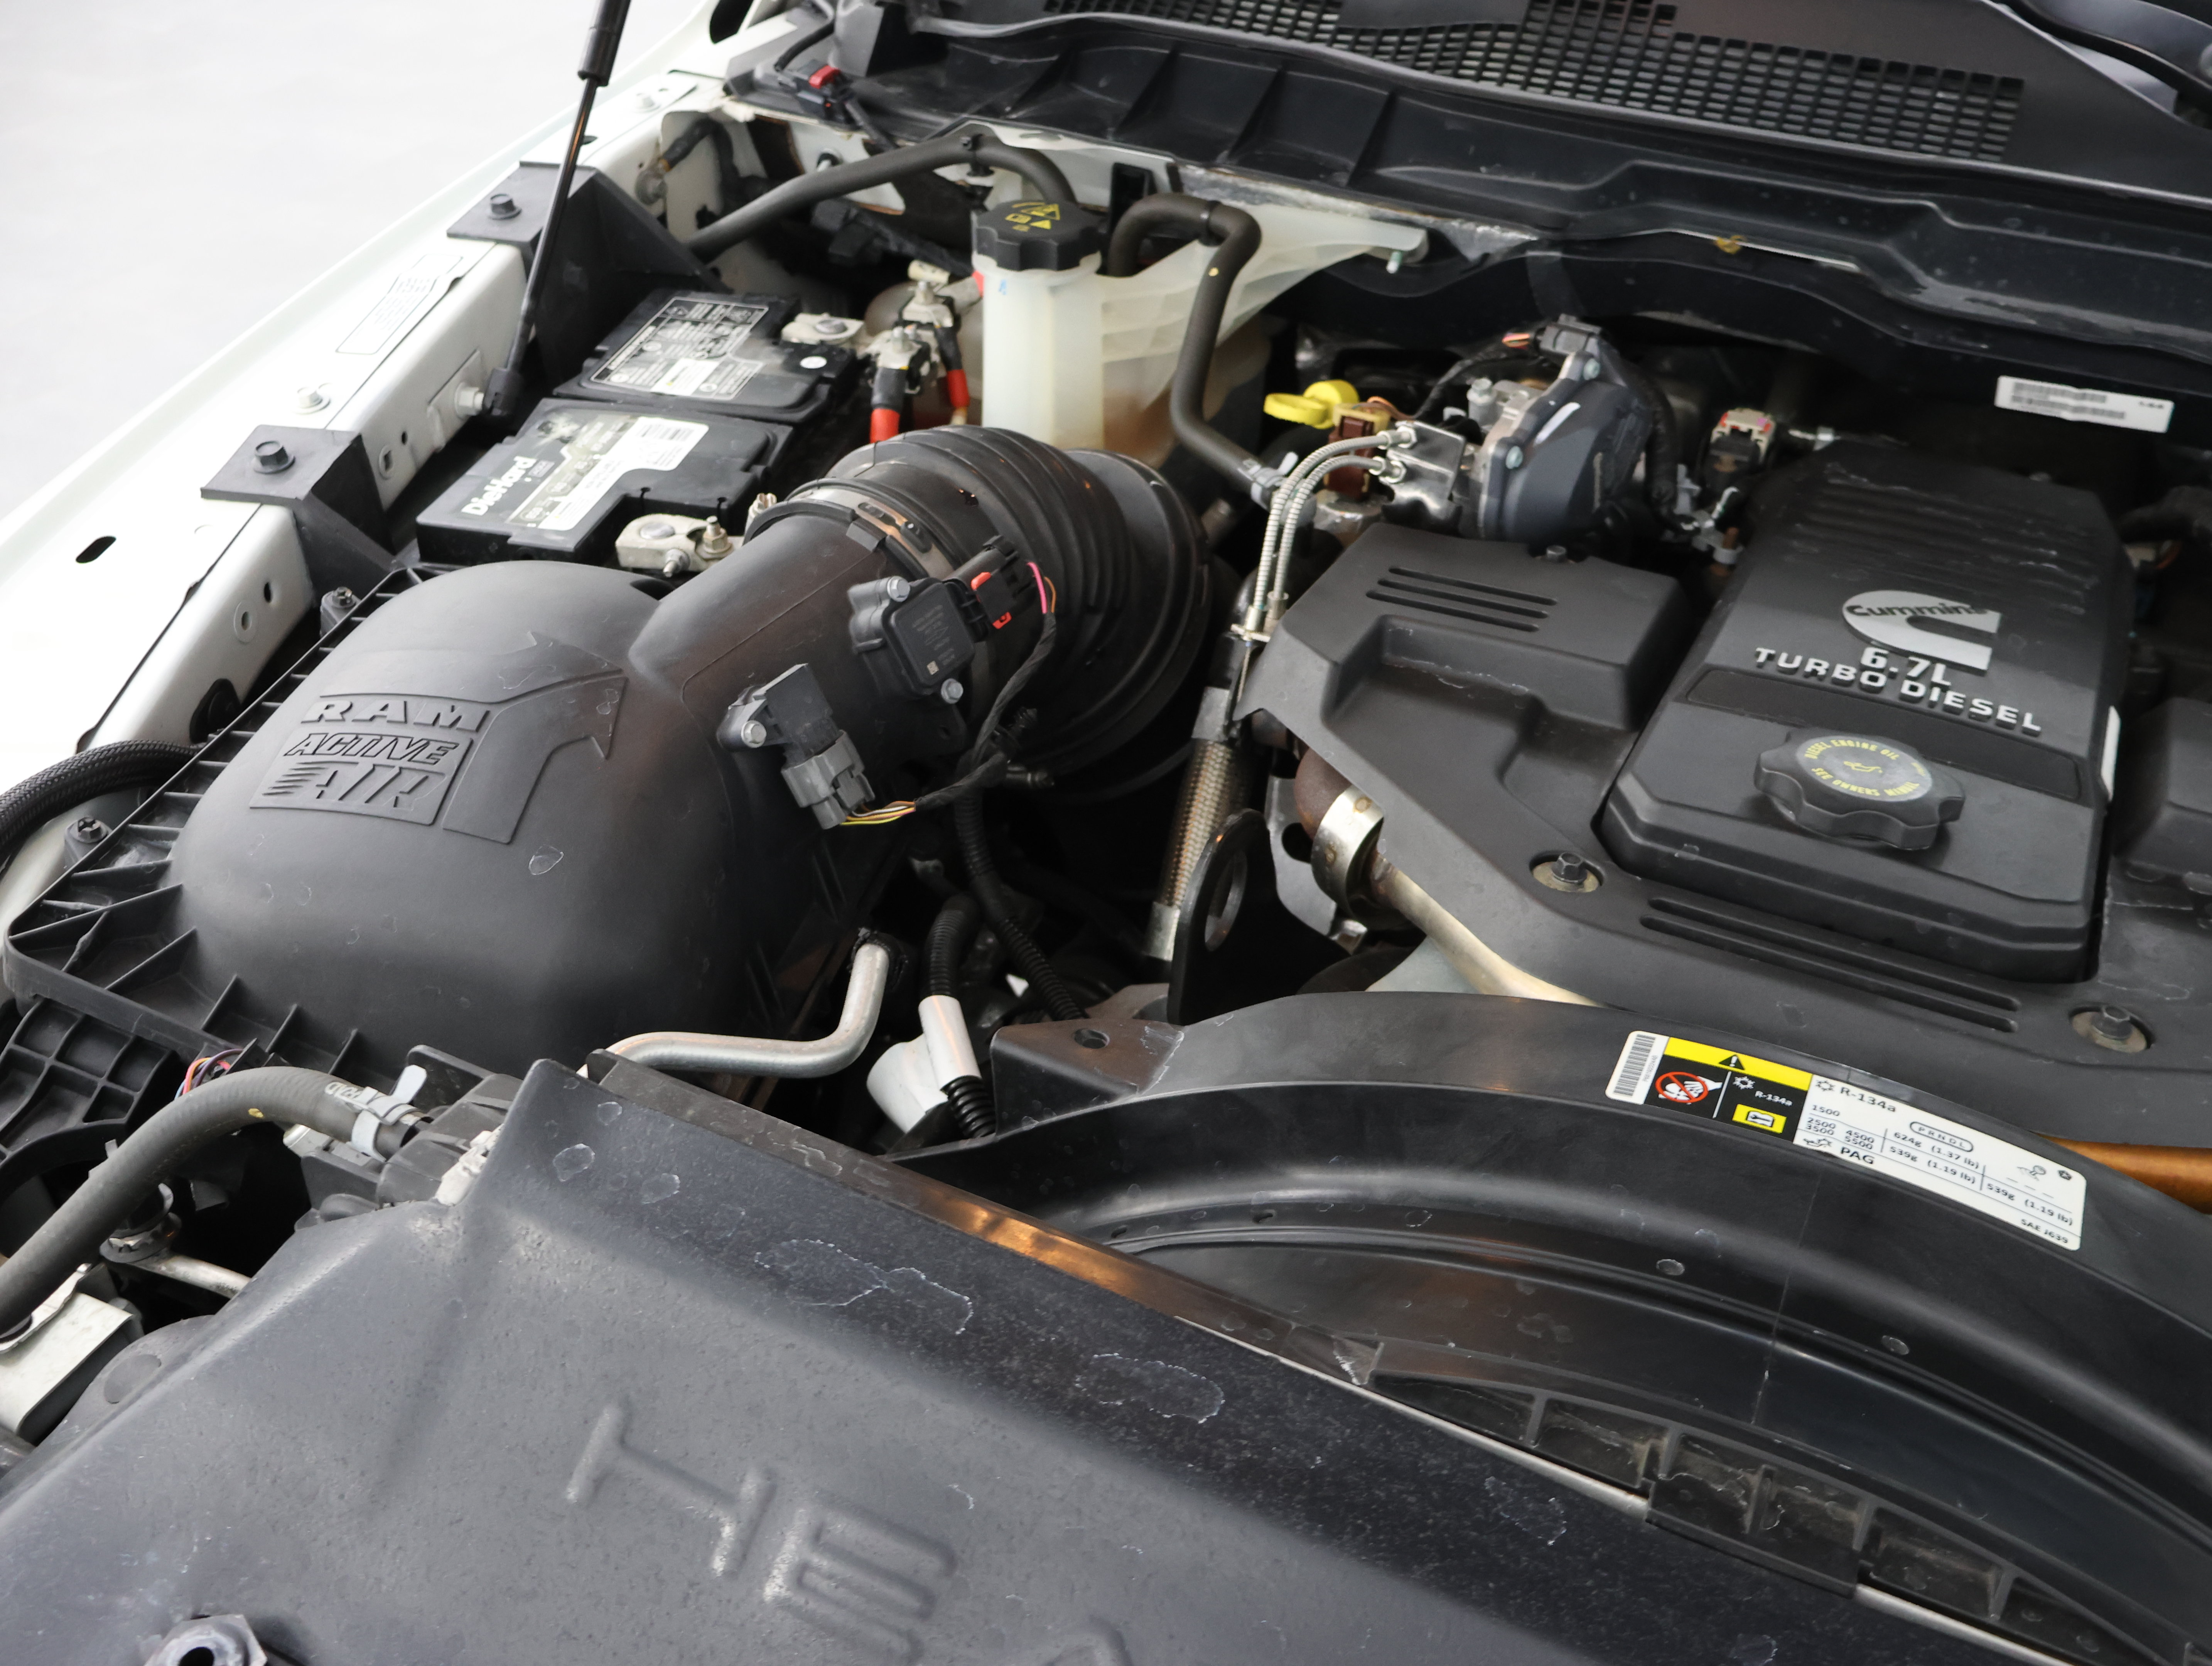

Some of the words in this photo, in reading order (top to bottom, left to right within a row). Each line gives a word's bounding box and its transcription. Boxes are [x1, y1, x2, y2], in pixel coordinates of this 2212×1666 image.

[461, 456, 537, 516] DieHard
[1859, 646, 1951, 687] 6.7L
[1755, 647, 1888, 692] TURBO
[1900, 680, 2041, 735] DIESEL
[301, 700, 491, 732] RAM
[283, 733, 460, 765] ACTIVE
[1804, 742, 1832, 759] DIESEL
[1830, 739, 1878, 752] ENGINE
[1880, 749, 1900, 760] OIL
[1811, 767, 1834, 780] SEE
[1832, 779, 1881, 797] OWNERS
[1755, 1090, 1793, 1107] R-134a
[1812, 1104, 1840, 1116] 1500
[1839, 1086, 1896, 1112] R-134a
[1806, 1123, 1835, 1135] 3500
[1845, 1136, 1873, 1150] 5500
[1807, 1117, 1836, 1129] 2500
[1845, 1130, 1875, 1144] 4500
[1893, 1132, 1923, 1147] 624g
[1841, 1147, 1875, 1164] PAG
[1890, 1146, 1918, 1162] 539g
[1987, 1183, 2015, 1201] 539g
[2021, 1218, 2041, 1231] SAE
[2044, 1229, 2069, 1244] J639
